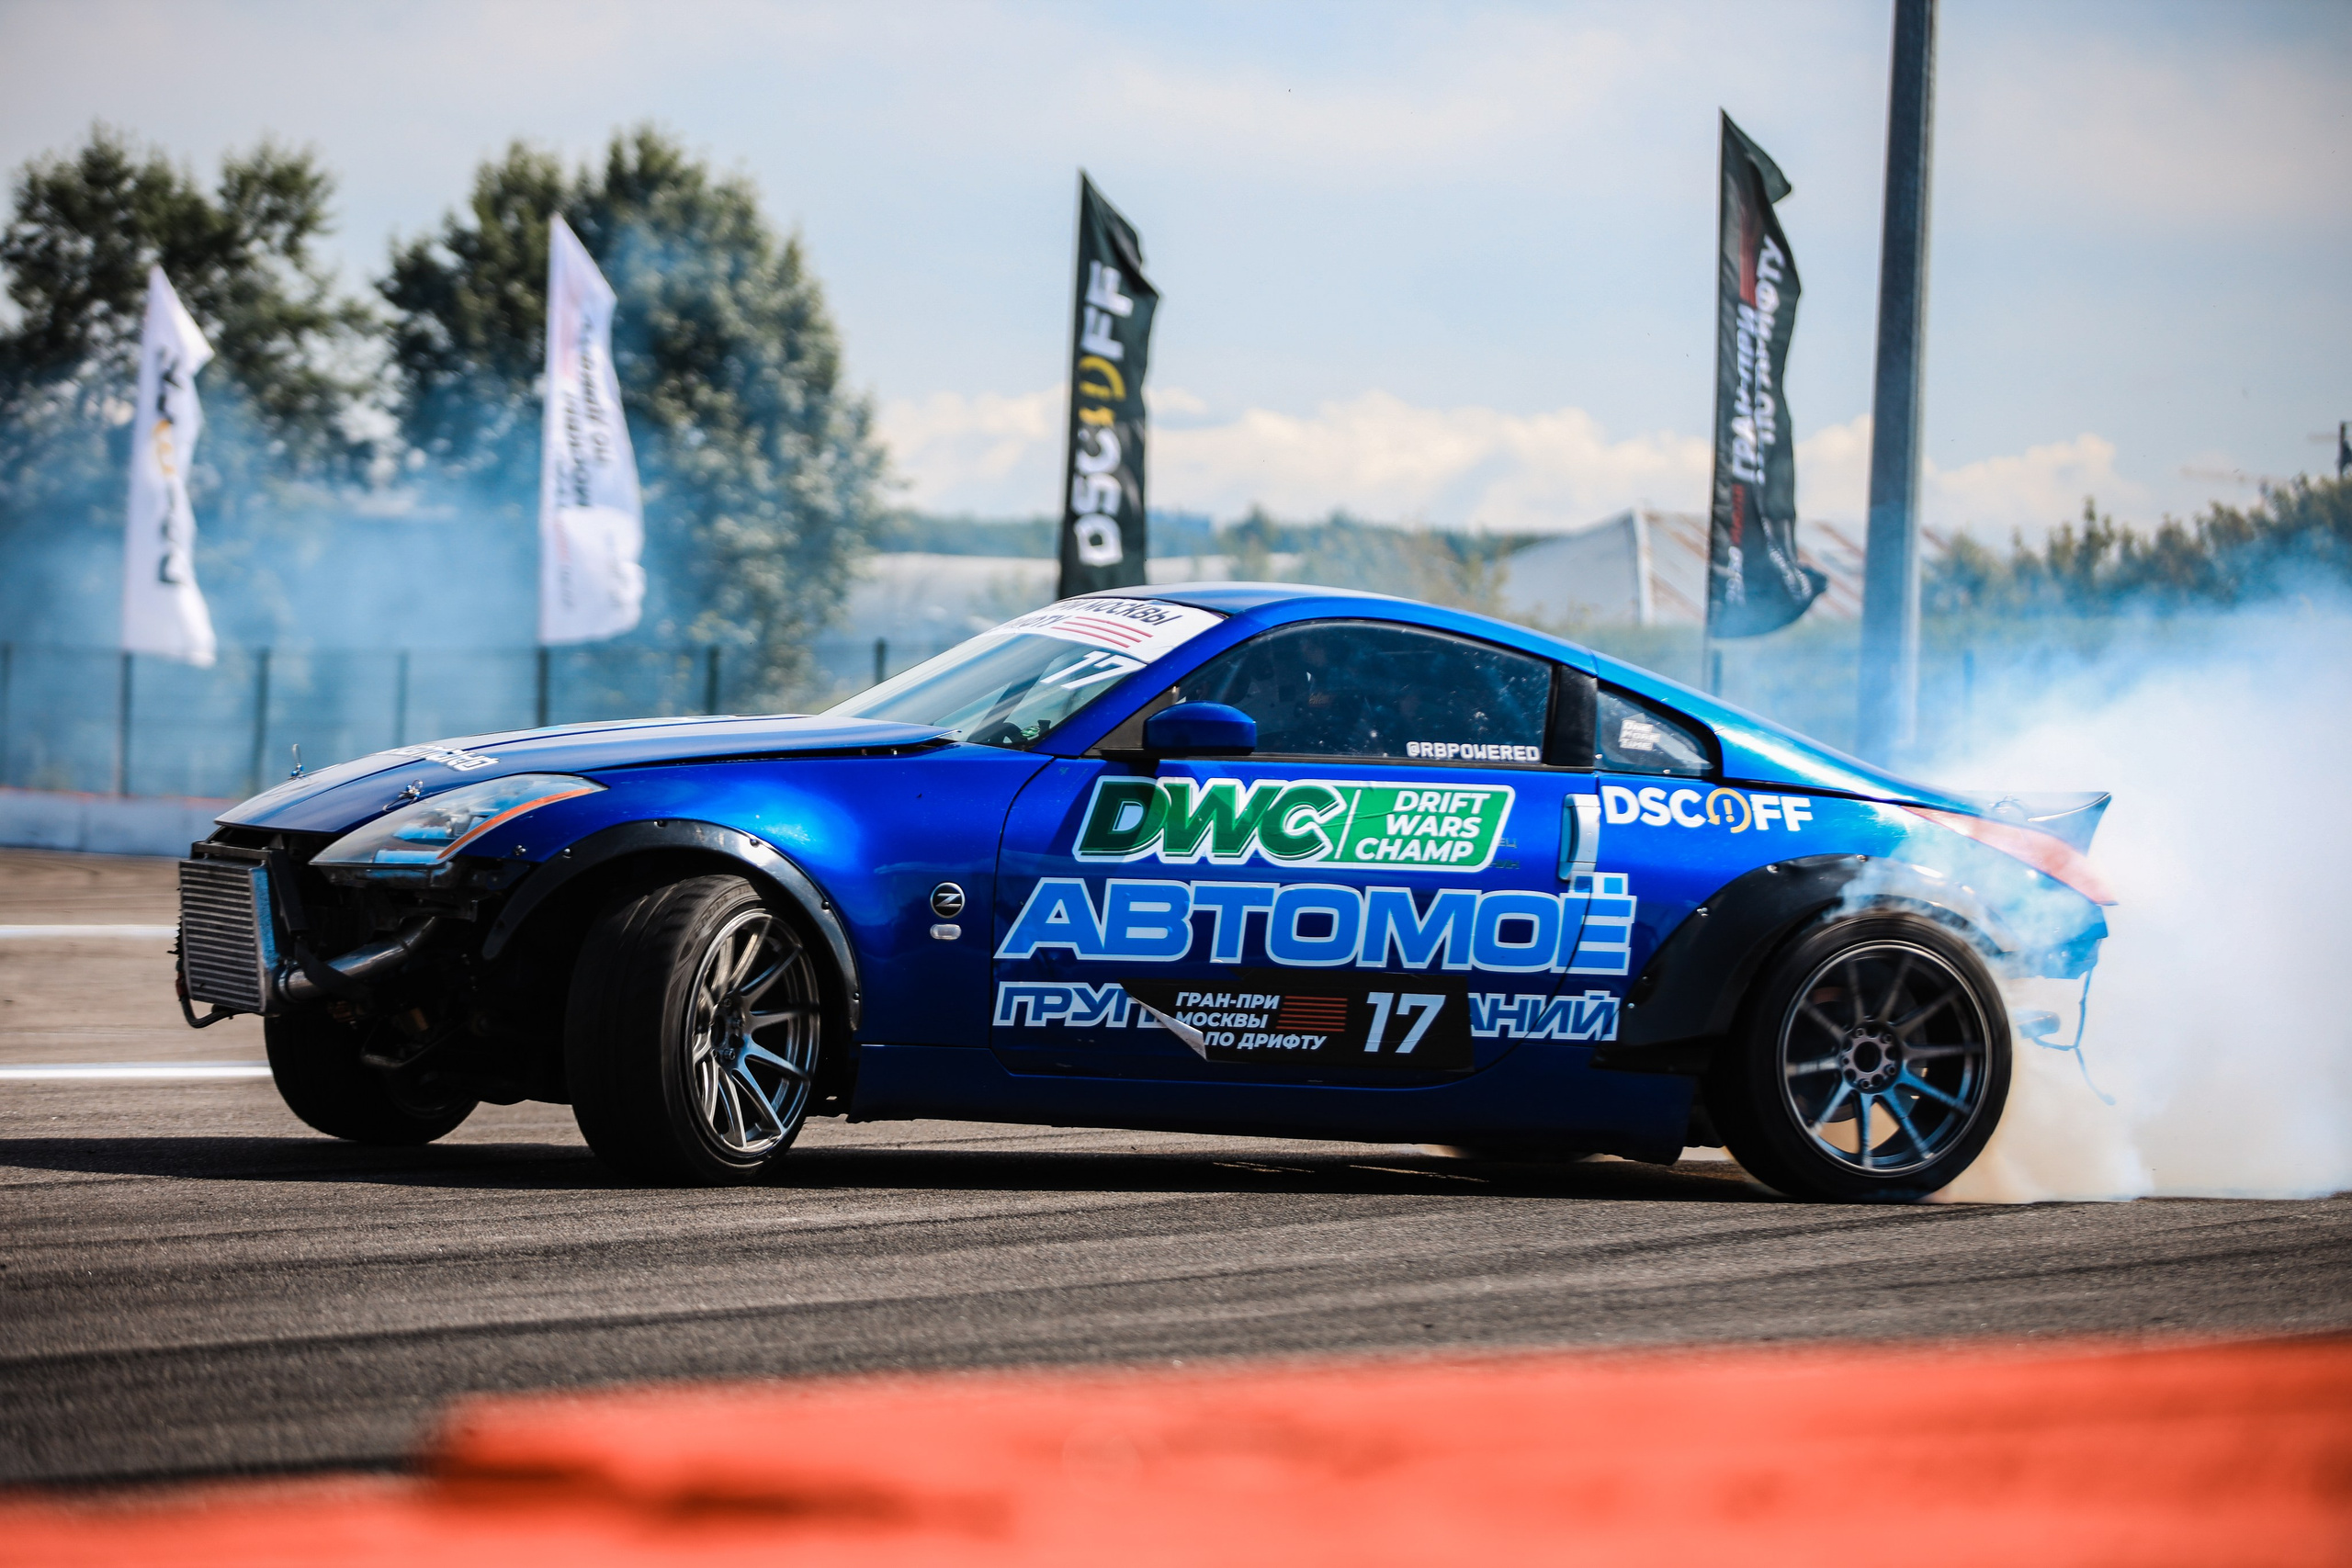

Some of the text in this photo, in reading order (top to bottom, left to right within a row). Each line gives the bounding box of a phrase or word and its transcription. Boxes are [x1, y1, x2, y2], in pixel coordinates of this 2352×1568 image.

[1040, 650, 1147, 690] 17
[1406, 741, 1541, 761] @RBPOWERED
[1392, 791, 1491, 815] DRIFT
[1073, 776, 1346, 863] DWC
[1385, 814, 1482, 839] WARS
[1354, 838, 1475, 863] CHAMP
[993, 872, 1637, 976] АВТОМОЁ
[992, 981, 1621, 1042] ГРУП АНИЙ
[1175, 991, 1446, 1054] ГРАН-ПРИ 17
[1176, 1011, 1268, 1030] МОСКВЫ
[1204, 1031, 1327, 1051] ПО ДРИФТУ
